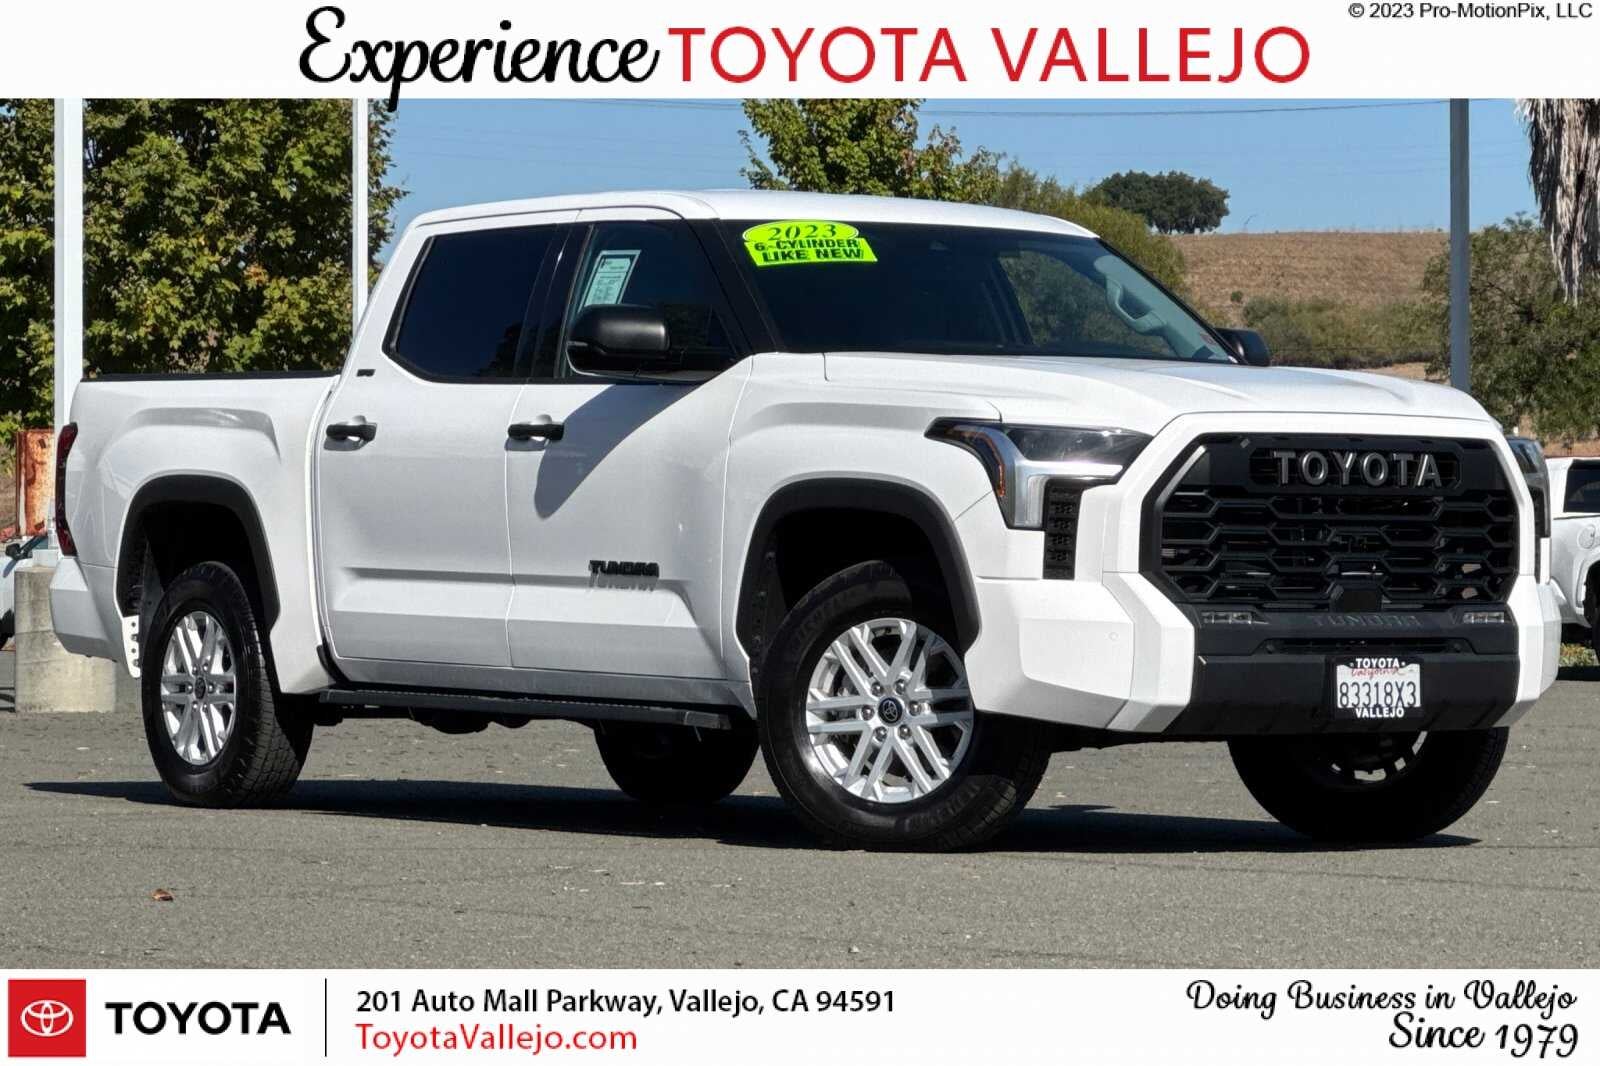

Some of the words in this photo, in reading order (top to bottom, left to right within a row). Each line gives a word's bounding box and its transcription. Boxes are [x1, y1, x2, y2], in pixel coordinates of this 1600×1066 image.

[768, 225, 836, 240] 2023
[762, 250, 809, 262] LIKE
[815, 249, 862, 260] NEW
[1274, 450, 1442, 488] TOYOTA
[1356, 658, 1400, 668] TOYOTA
[1340, 681, 1416, 707] 83318X3
[1355, 707, 1405, 718] VALLEJO
